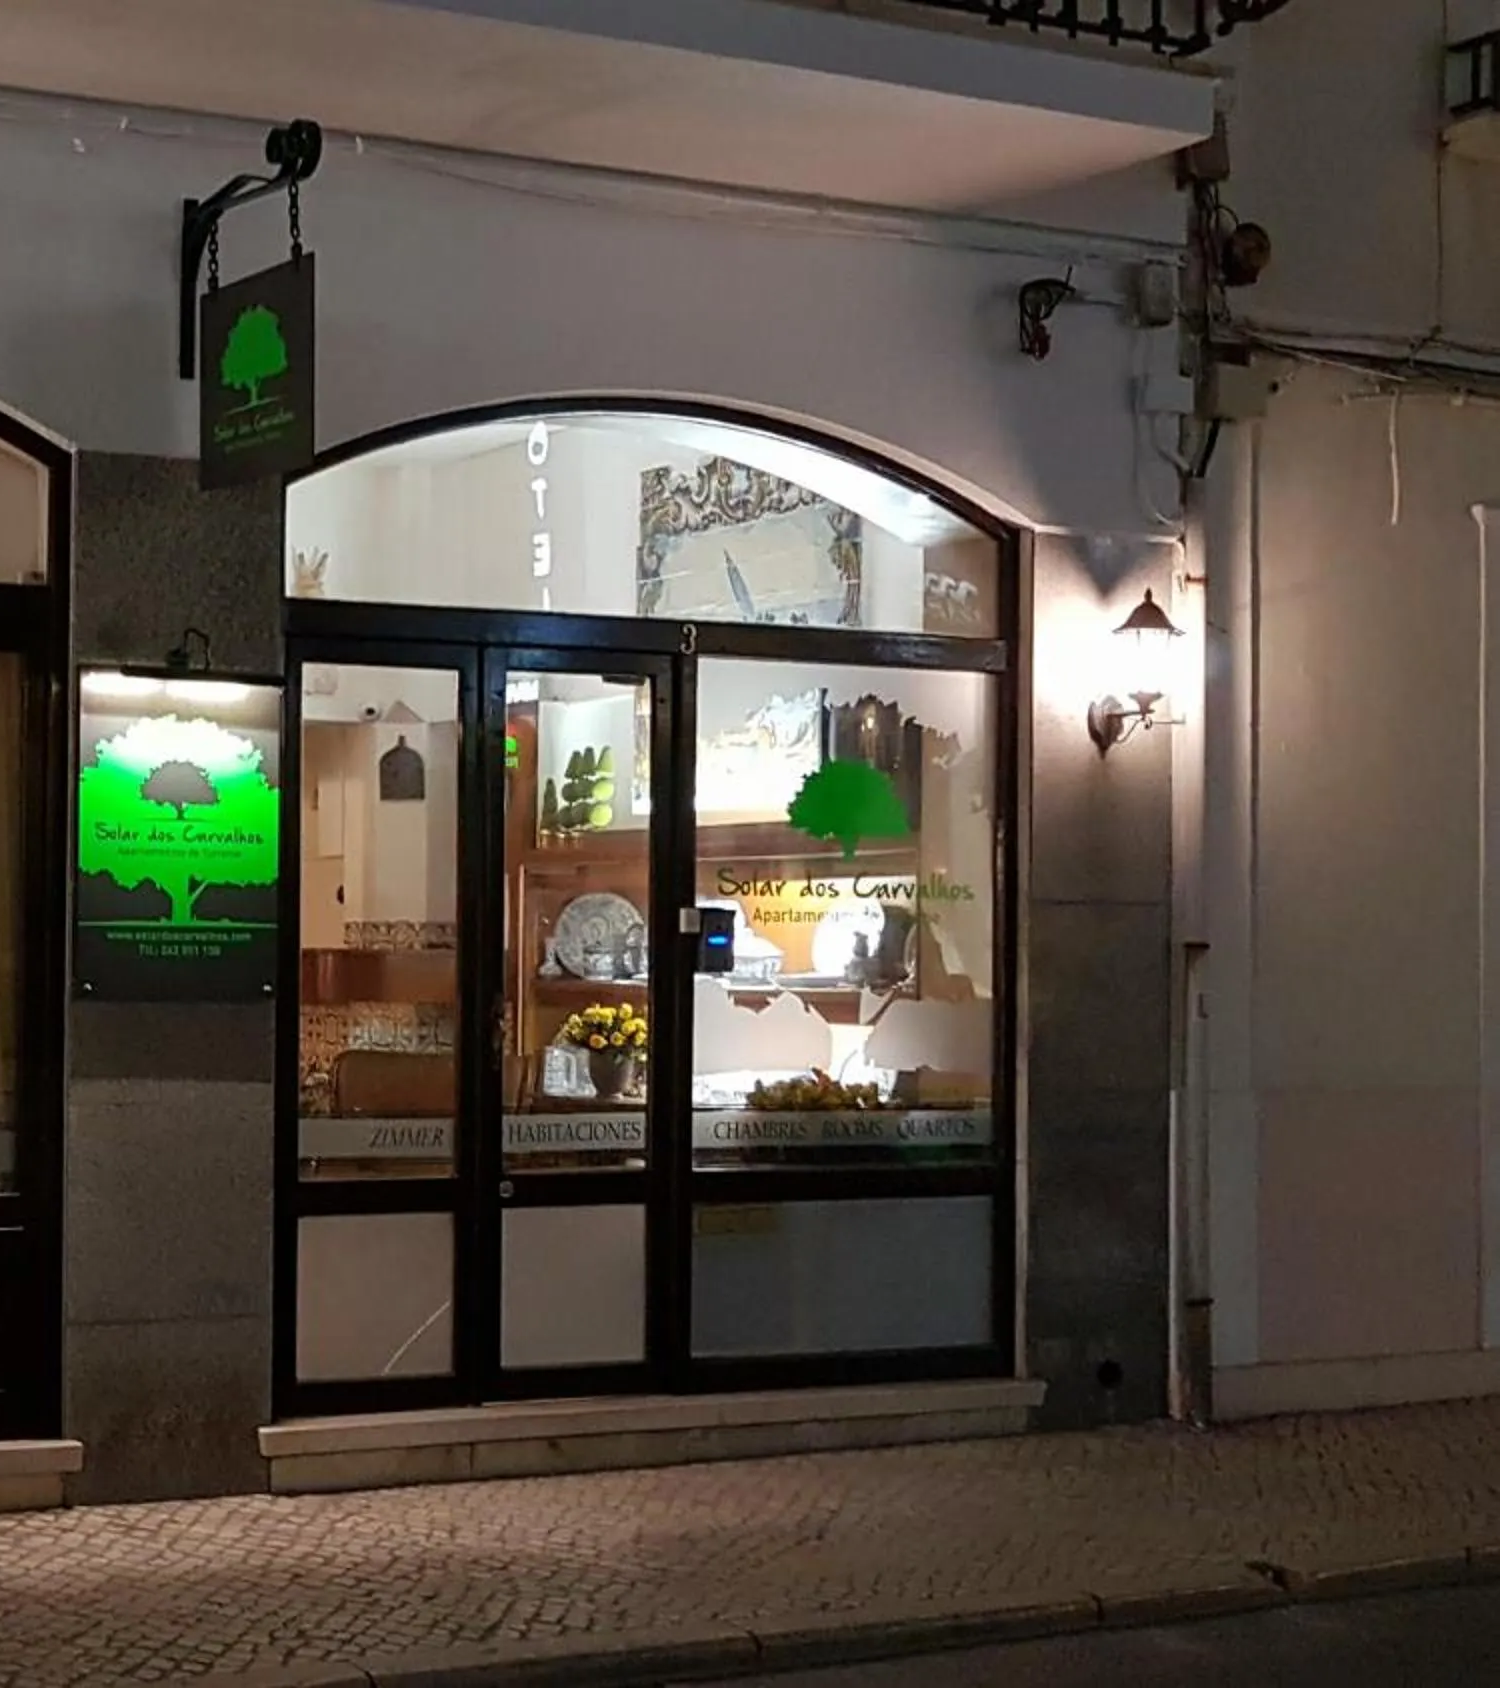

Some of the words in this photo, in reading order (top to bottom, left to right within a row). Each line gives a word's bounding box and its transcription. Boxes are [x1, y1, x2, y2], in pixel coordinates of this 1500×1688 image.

[680, 623, 697, 655] 3
[94, 821, 141, 842] Solar
[148, 824, 175, 843] dos
[183, 824, 264, 845] Carvalhos
[716, 867, 786, 898] Solar
[799, 870, 840, 899] dos
[852, 869, 976, 901] Carvalhos
[369, 1126, 444, 1149] ZIMMER
[508, 1120, 642, 1145] HABITACIONES
[712, 1119, 807, 1141] CHAMBRES
[896, 1116, 975, 1141] QUARTOS
